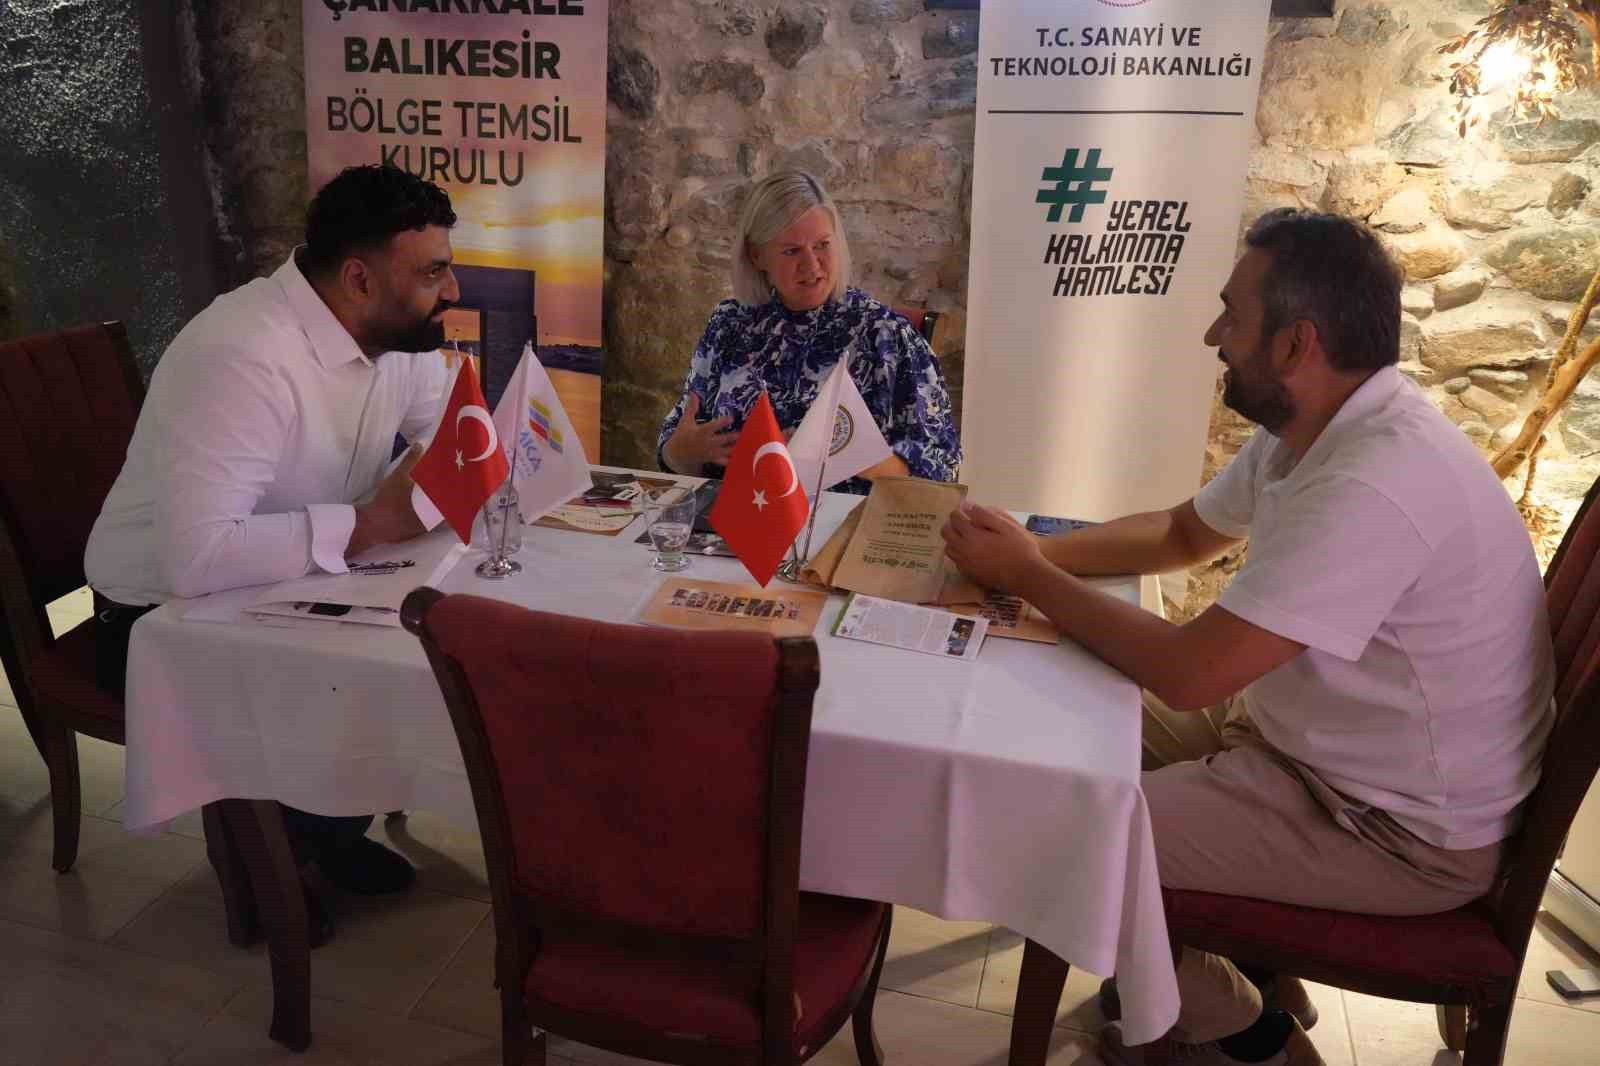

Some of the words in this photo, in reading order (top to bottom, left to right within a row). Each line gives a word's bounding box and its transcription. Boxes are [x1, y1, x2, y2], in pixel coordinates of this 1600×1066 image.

[1036, 28, 1074, 47] T.C.
[1081, 23, 1165, 47] SANAYİ
[1171, 27, 1202, 47] VE
[343, 29, 561, 80] BALIKESİR
[990, 52, 1117, 77] TEKNOLOJİ
[1122, 53, 1252, 77] BAKANLIĞI
[327, 88, 442, 136] BÖLGE
[453, 96, 582, 143] TEMSİL
[380, 144, 524, 187] KURULU
[1106, 200, 1192, 232] YEREL
[1043, 233, 1185, 265] KALKINMA
